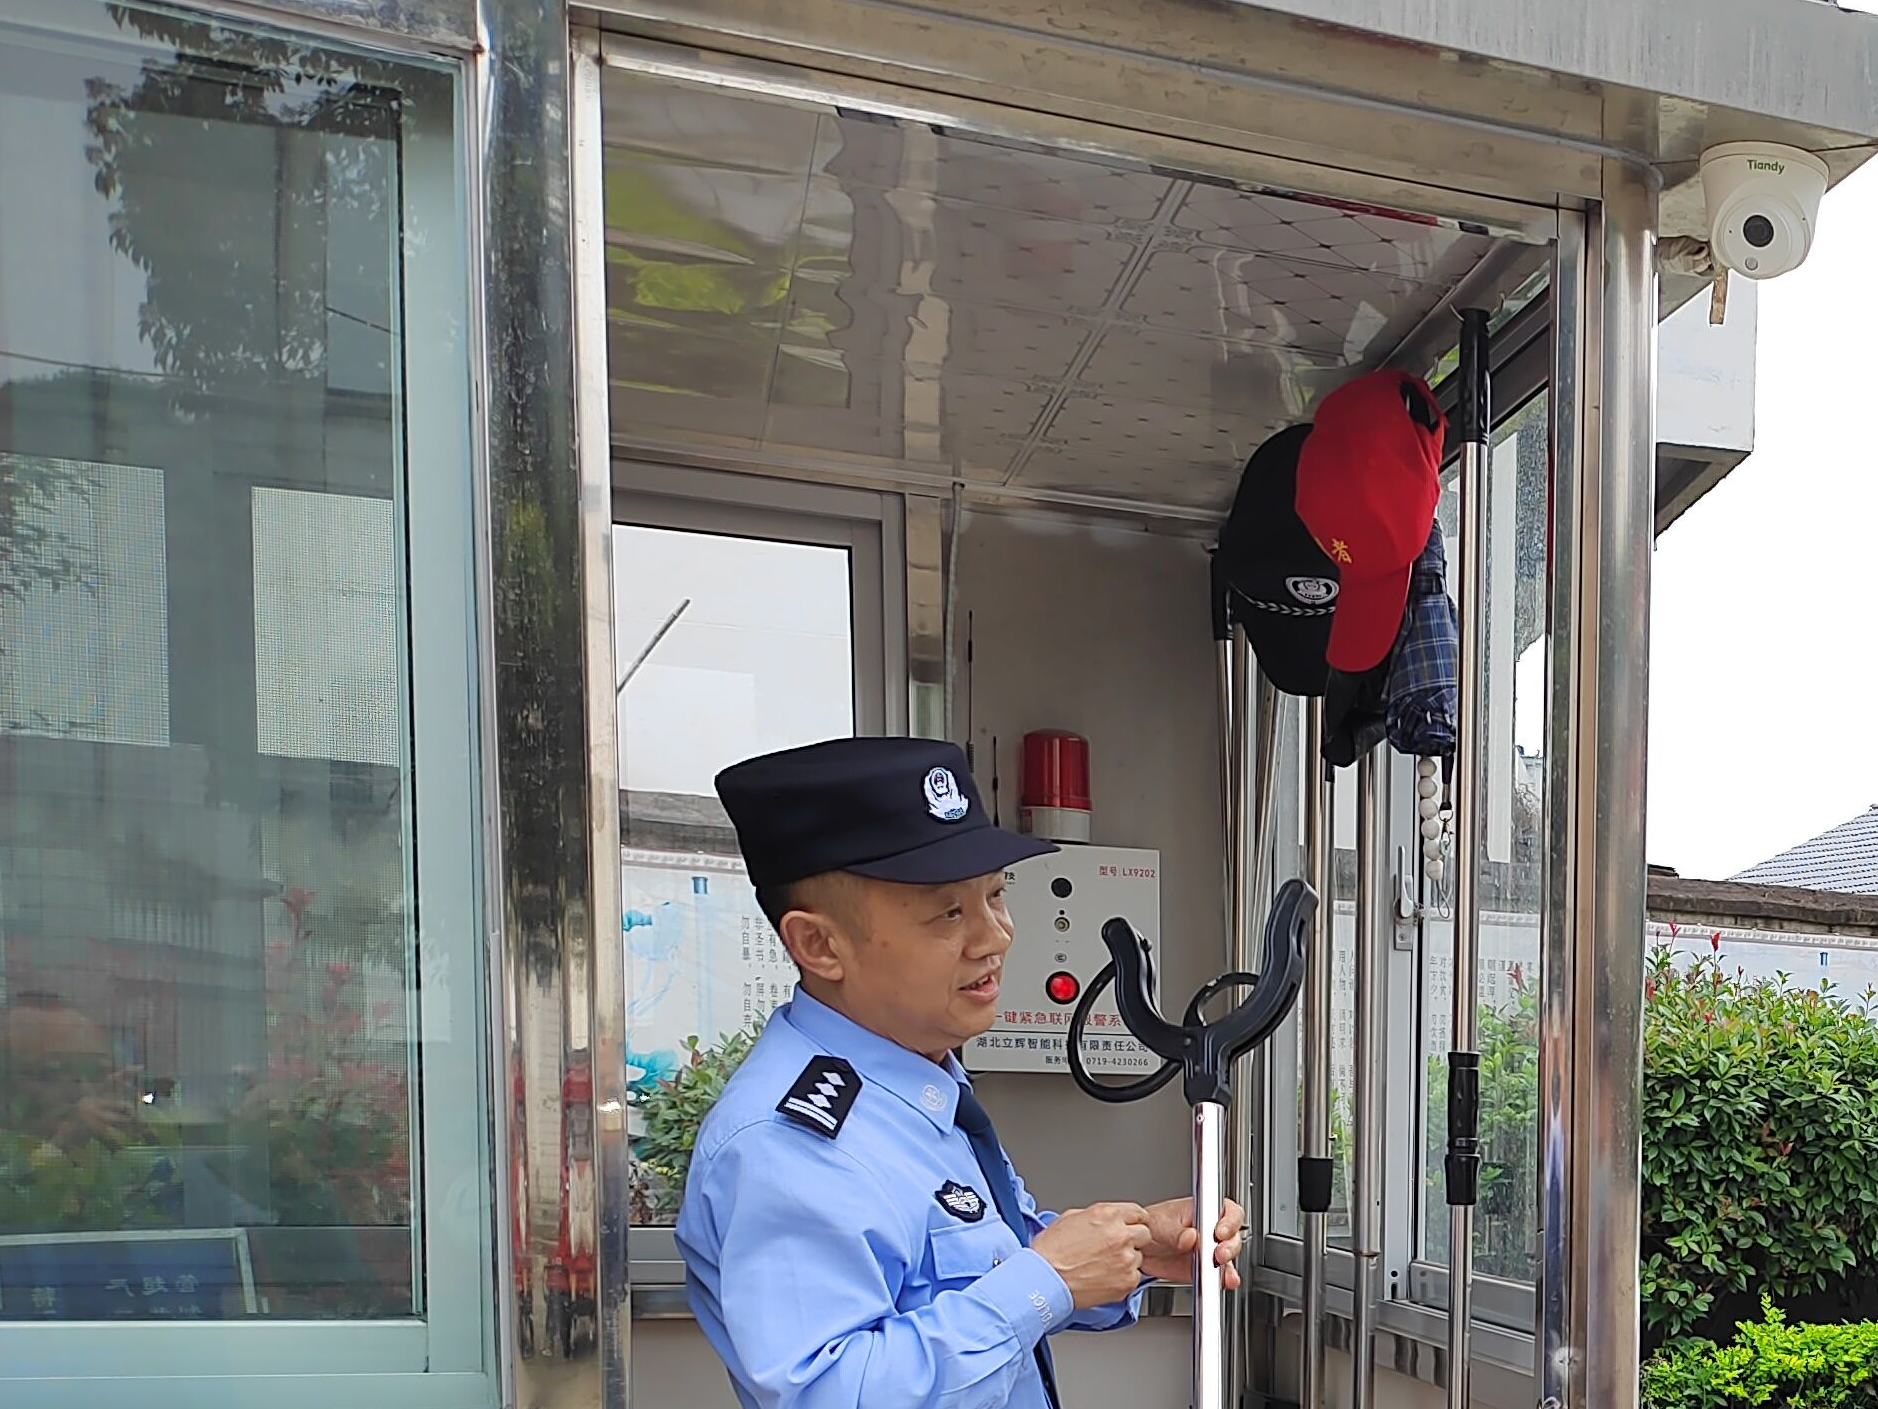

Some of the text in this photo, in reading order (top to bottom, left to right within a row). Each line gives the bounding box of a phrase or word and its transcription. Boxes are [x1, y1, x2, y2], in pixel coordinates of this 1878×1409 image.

[1747, 159, 1785, 175] Tiandy
[976, 1037, 1149, 1052] 湖北立辉智能科有限责任公司
